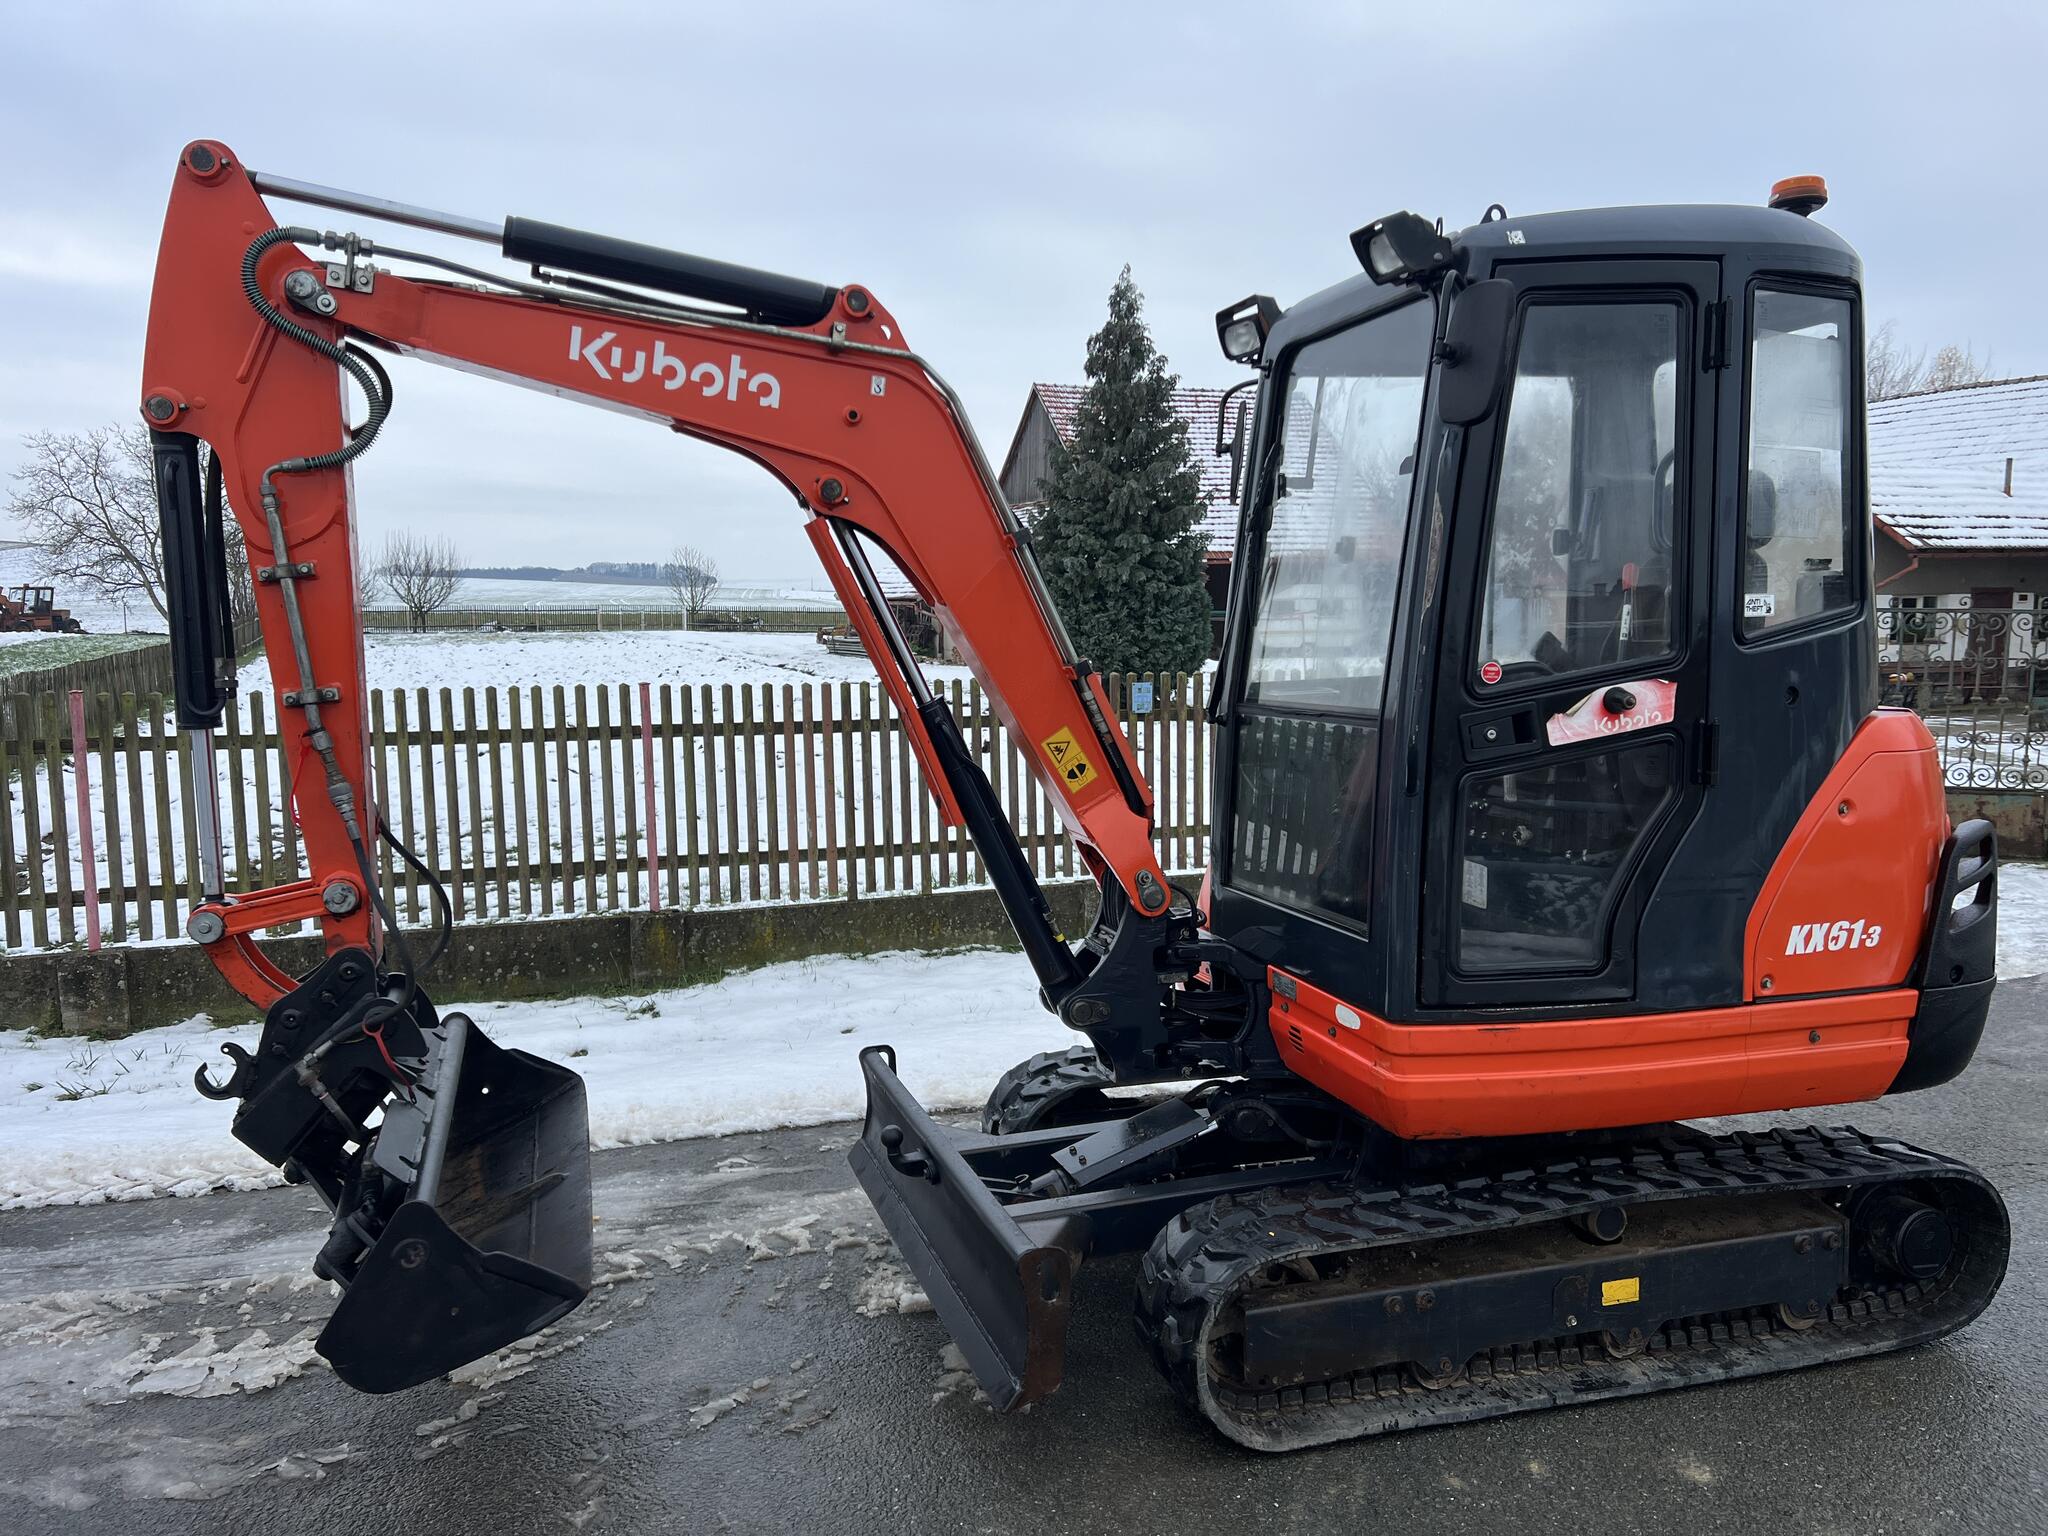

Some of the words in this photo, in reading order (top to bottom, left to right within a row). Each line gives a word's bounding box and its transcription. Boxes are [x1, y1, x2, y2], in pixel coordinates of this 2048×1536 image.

[568, 325, 781, 409] Kubota
[1594, 709, 1662, 733] Kubota
[1784, 918, 1882, 956] KX61-3
